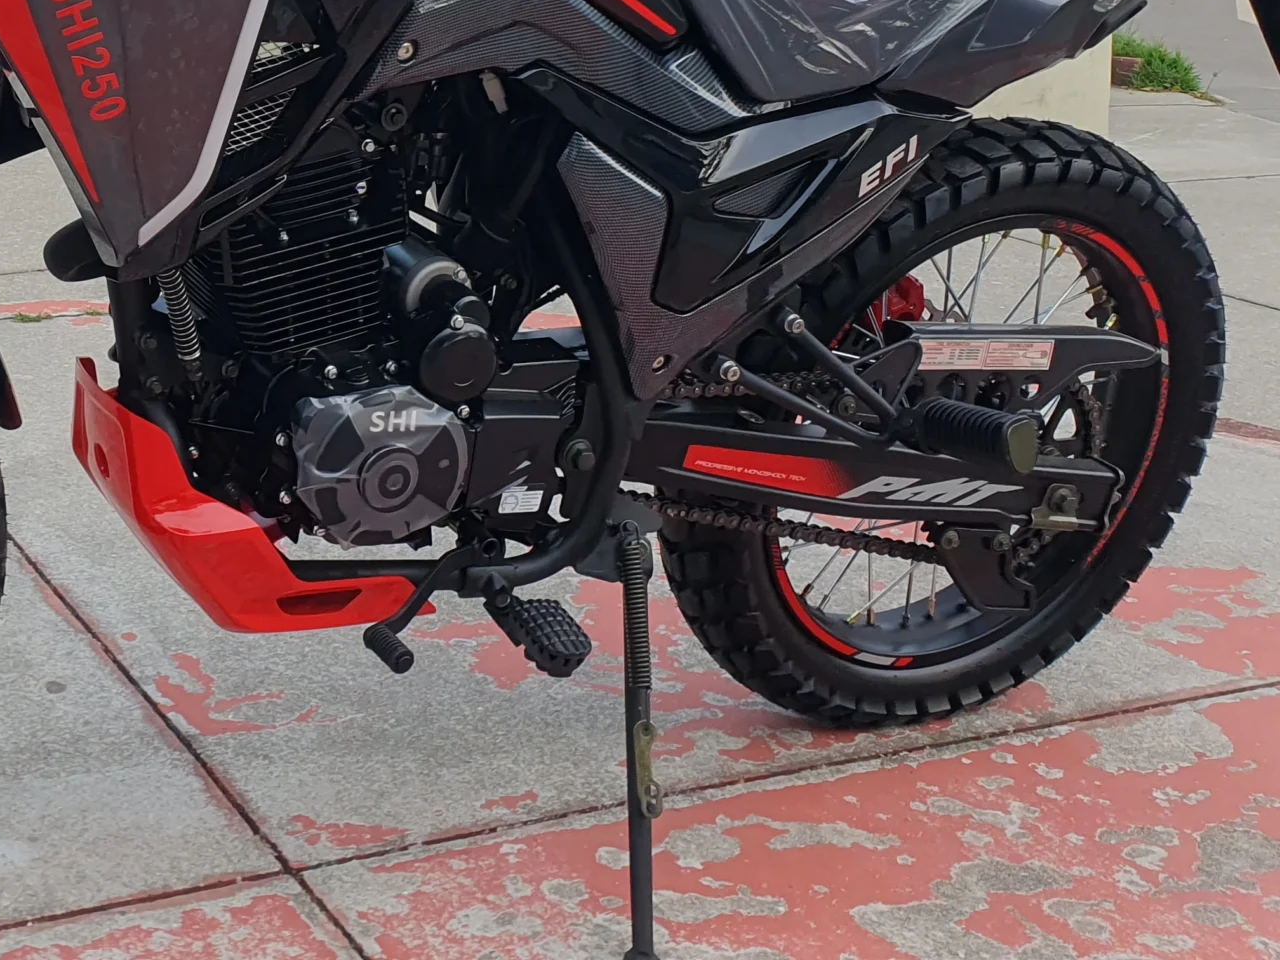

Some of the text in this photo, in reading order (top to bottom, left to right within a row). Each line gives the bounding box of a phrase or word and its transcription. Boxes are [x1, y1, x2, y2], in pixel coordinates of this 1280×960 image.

[858, 134, 919, 199] EFI
[370, 410, 417, 432] SHI
[695, 459, 807, 482] PROGRESSIVE MONOSHOCK TECH
[836, 475, 1024, 506] PMT
